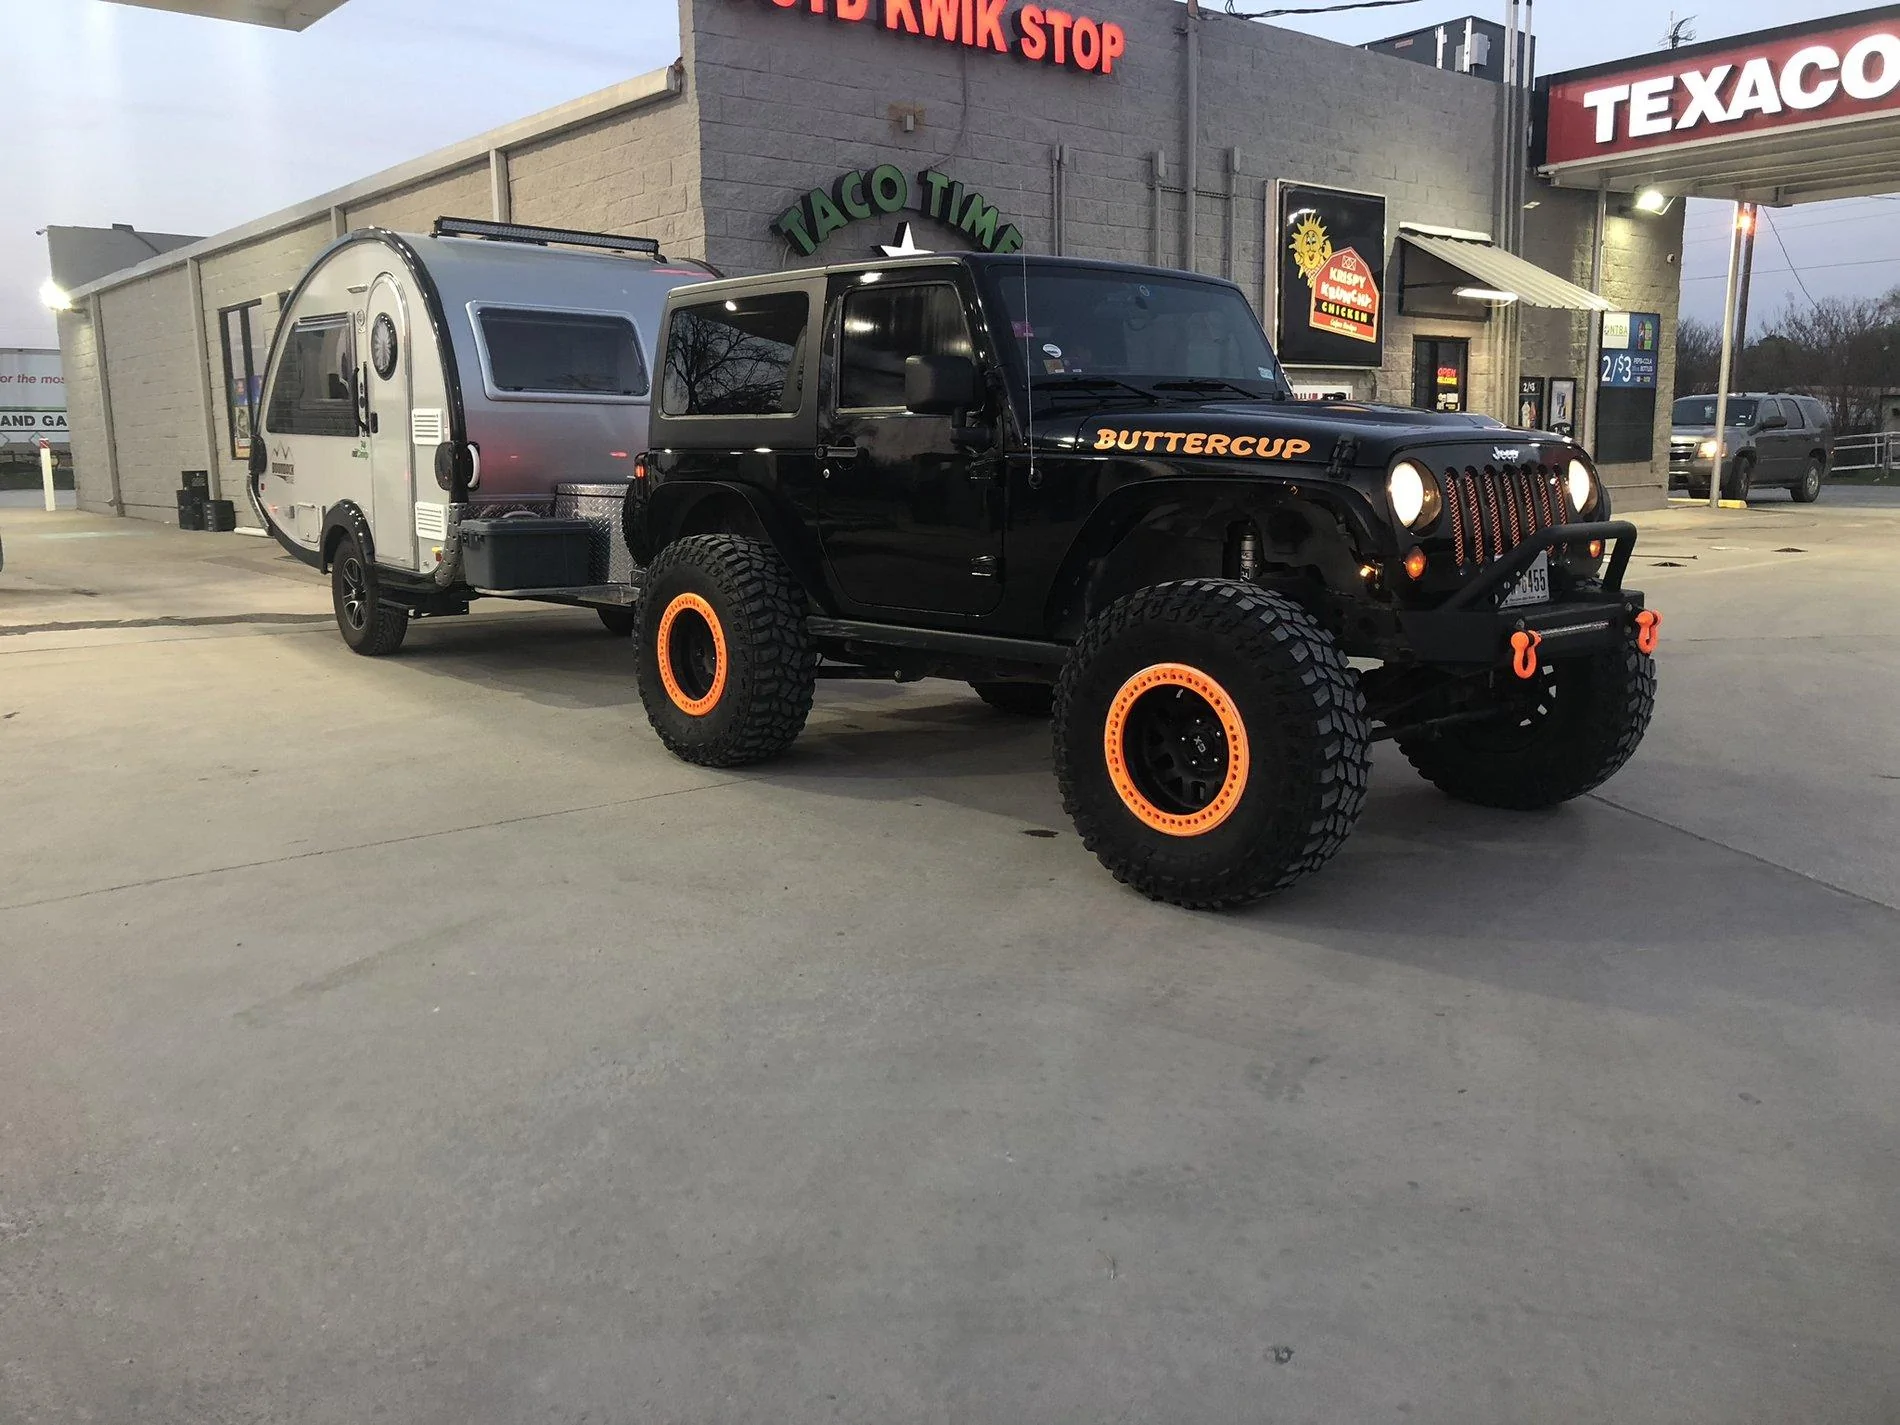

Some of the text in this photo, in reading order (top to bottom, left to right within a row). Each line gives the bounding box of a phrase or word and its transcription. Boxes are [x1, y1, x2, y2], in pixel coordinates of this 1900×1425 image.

[886, 0, 1124, 74] KWIK STOP
[1583, 33, 1900, 143] TEXACO
[776, 163, 907, 256] TACO
[1329, 267, 1366, 288] KRISPY
[1321, 301, 1368, 323] CHICKEN
[17, 373, 37, 384] the
[1437, 367, 1457, 377] OPEN
[1601, 354, 1632, 382] 2/$3
[0, 415, 36, 426] AND
[1093, 428, 1311, 459] BUTTERCUP
[1492, 446, 1519, 463] Jeep
